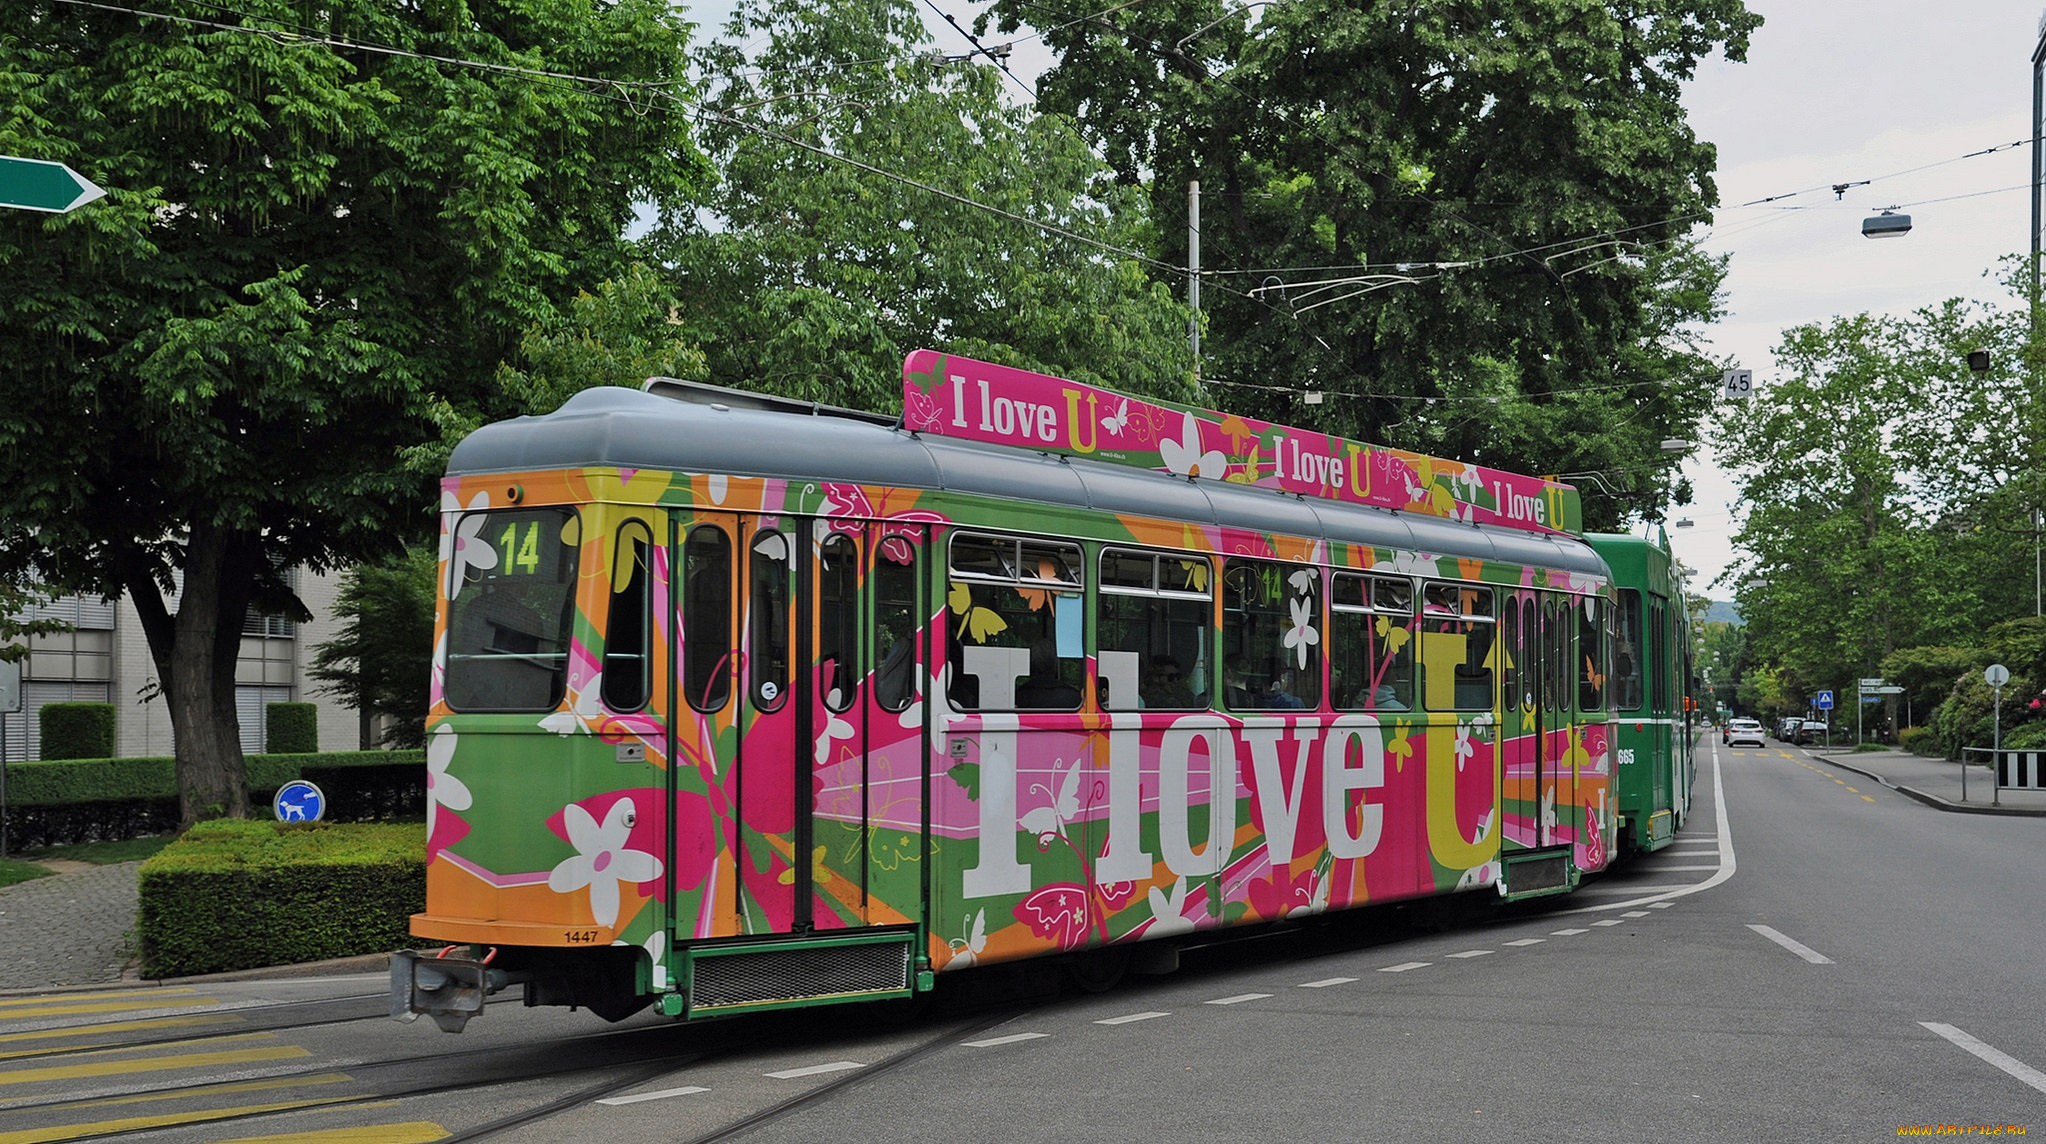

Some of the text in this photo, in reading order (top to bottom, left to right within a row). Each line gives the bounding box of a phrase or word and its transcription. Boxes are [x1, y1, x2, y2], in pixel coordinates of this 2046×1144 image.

[1727, 374, 1750, 392] 45
[950, 374, 1099, 454] I love U
[1272, 434, 1372, 498] I love U
[1493, 480, 1564, 531] I love U
[500, 520, 539, 576] 14
[1262, 566, 1283, 605] 14
[963, 626, 1515, 900] I love U
[1618, 748, 1635, 765] 665
[564, 930, 599, 943] 1447
